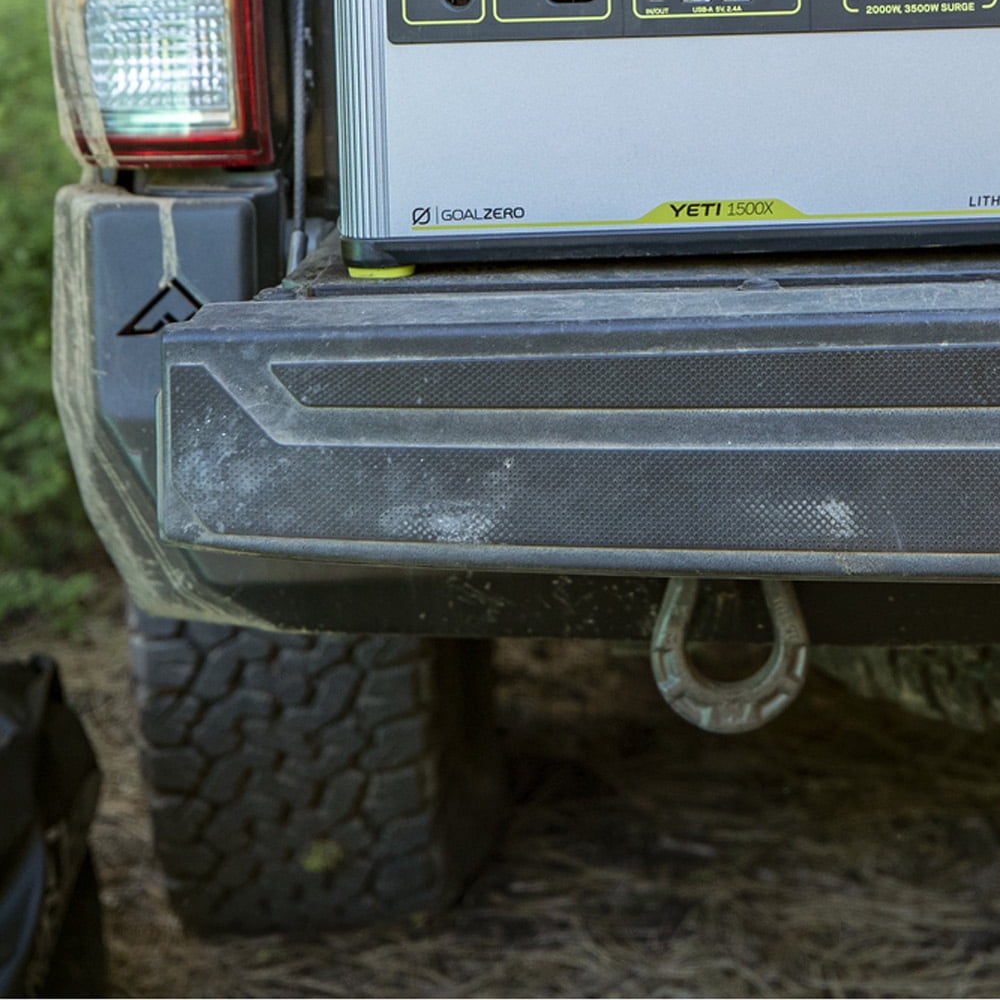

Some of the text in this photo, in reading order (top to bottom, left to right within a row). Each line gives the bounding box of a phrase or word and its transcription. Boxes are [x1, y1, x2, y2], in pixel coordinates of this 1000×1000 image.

[691, 6, 713, 14] USB-A
[904, 3, 940, 13] 3500W
[941, 2, 976, 12] SURGE
[669, 201, 775, 218] YETI 1500X
